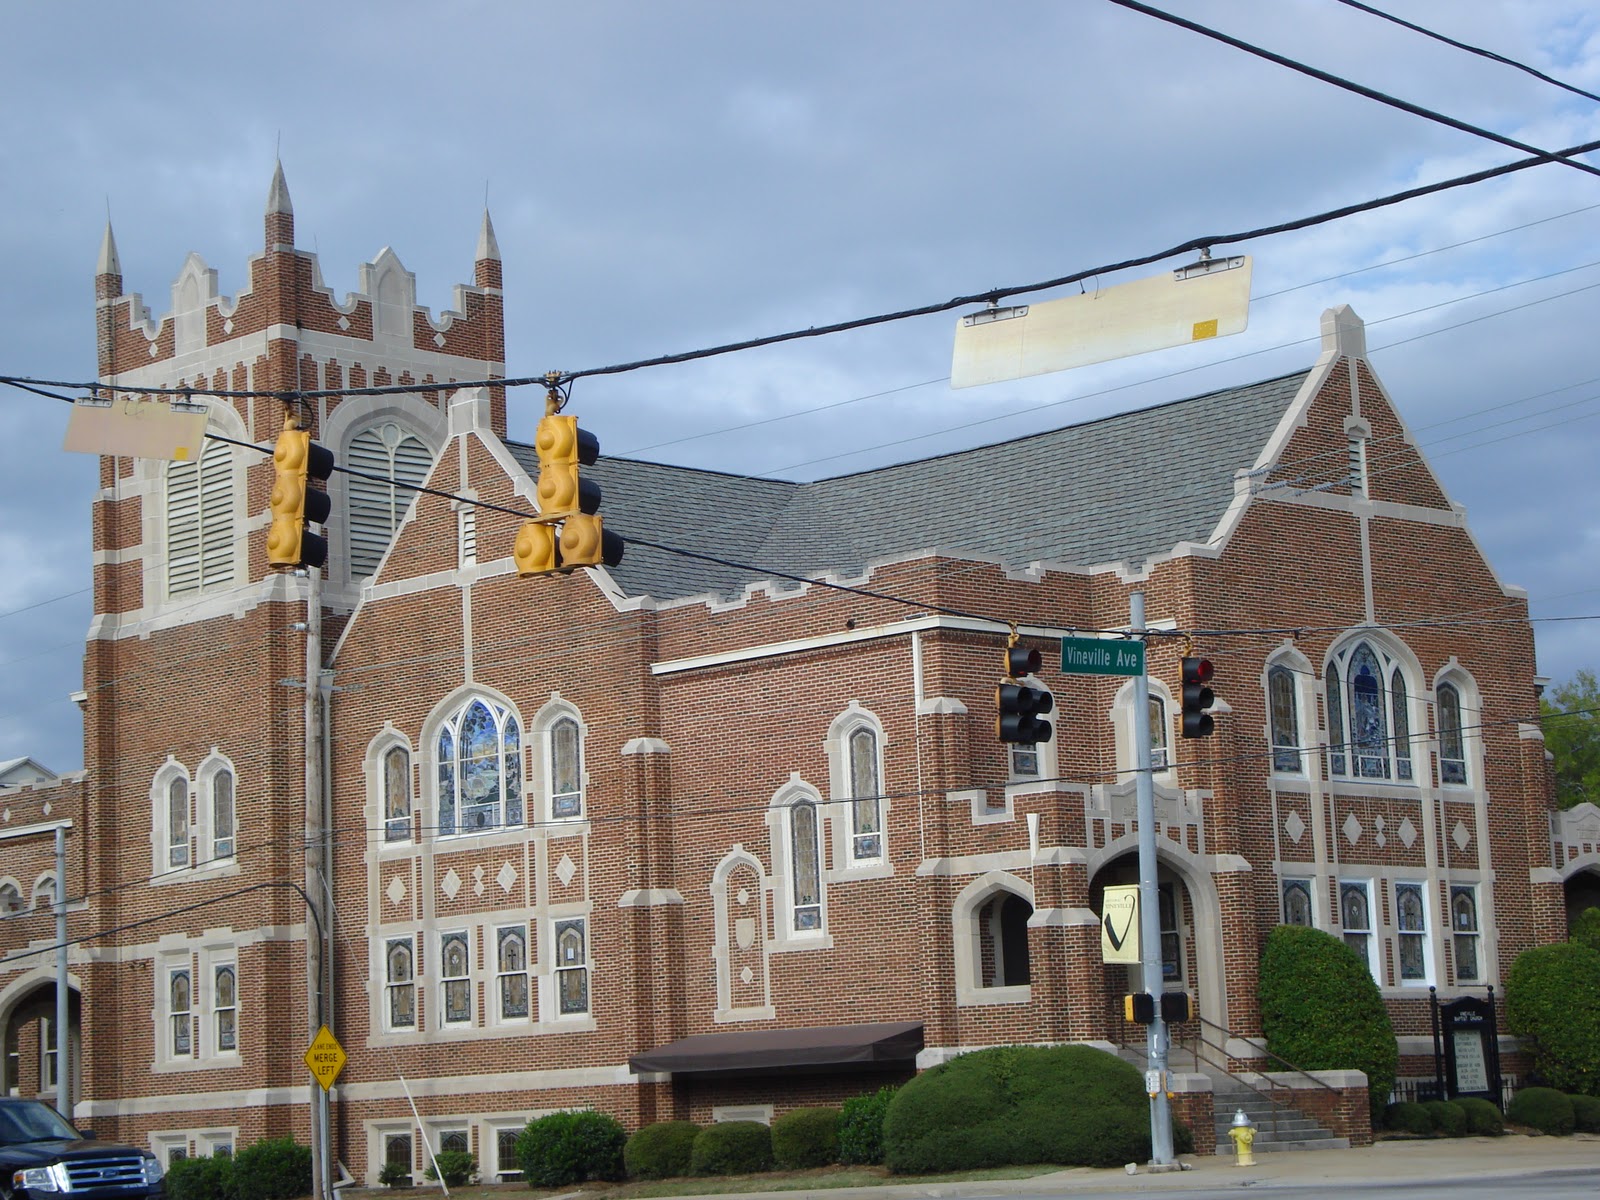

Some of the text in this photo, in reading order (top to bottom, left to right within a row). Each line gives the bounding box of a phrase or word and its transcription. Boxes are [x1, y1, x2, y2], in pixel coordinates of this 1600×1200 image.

[1067, 646, 1137, 667] Vineville Ave
[314, 1053, 338, 1063] MERGE
[318, 1065, 335, 1075] LEFT
